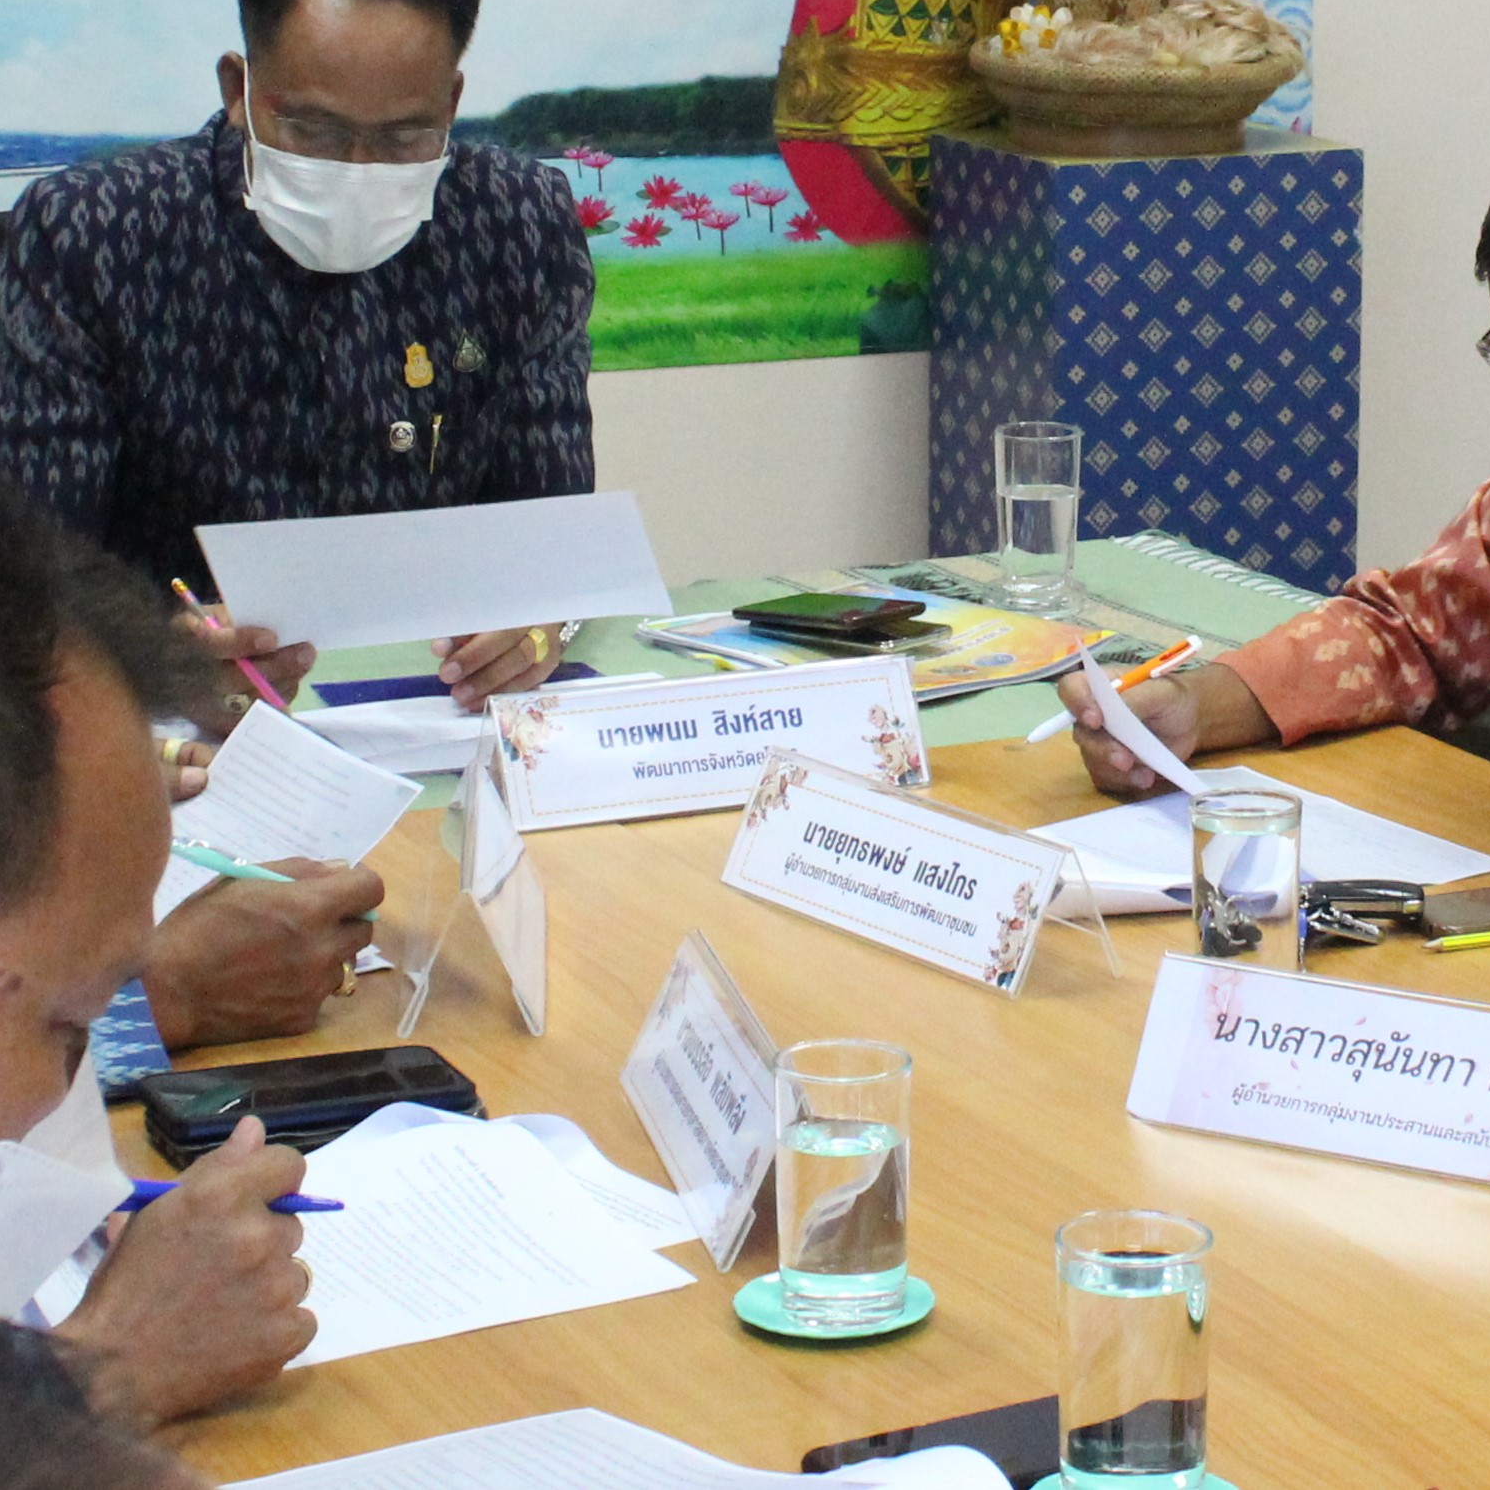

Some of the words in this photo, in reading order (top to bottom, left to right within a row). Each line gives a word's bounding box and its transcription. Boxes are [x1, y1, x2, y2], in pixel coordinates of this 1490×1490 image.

[598, 718, 699, 749] นายพนม
[712, 704, 803, 736] สิงห์สาย
[803, 820, 912, 875] นายยุทธพงษ์
[913, 860, 978, 900] แสงไกร
[1213, 1012, 1476, 1087] นางสาวสุนันทา
